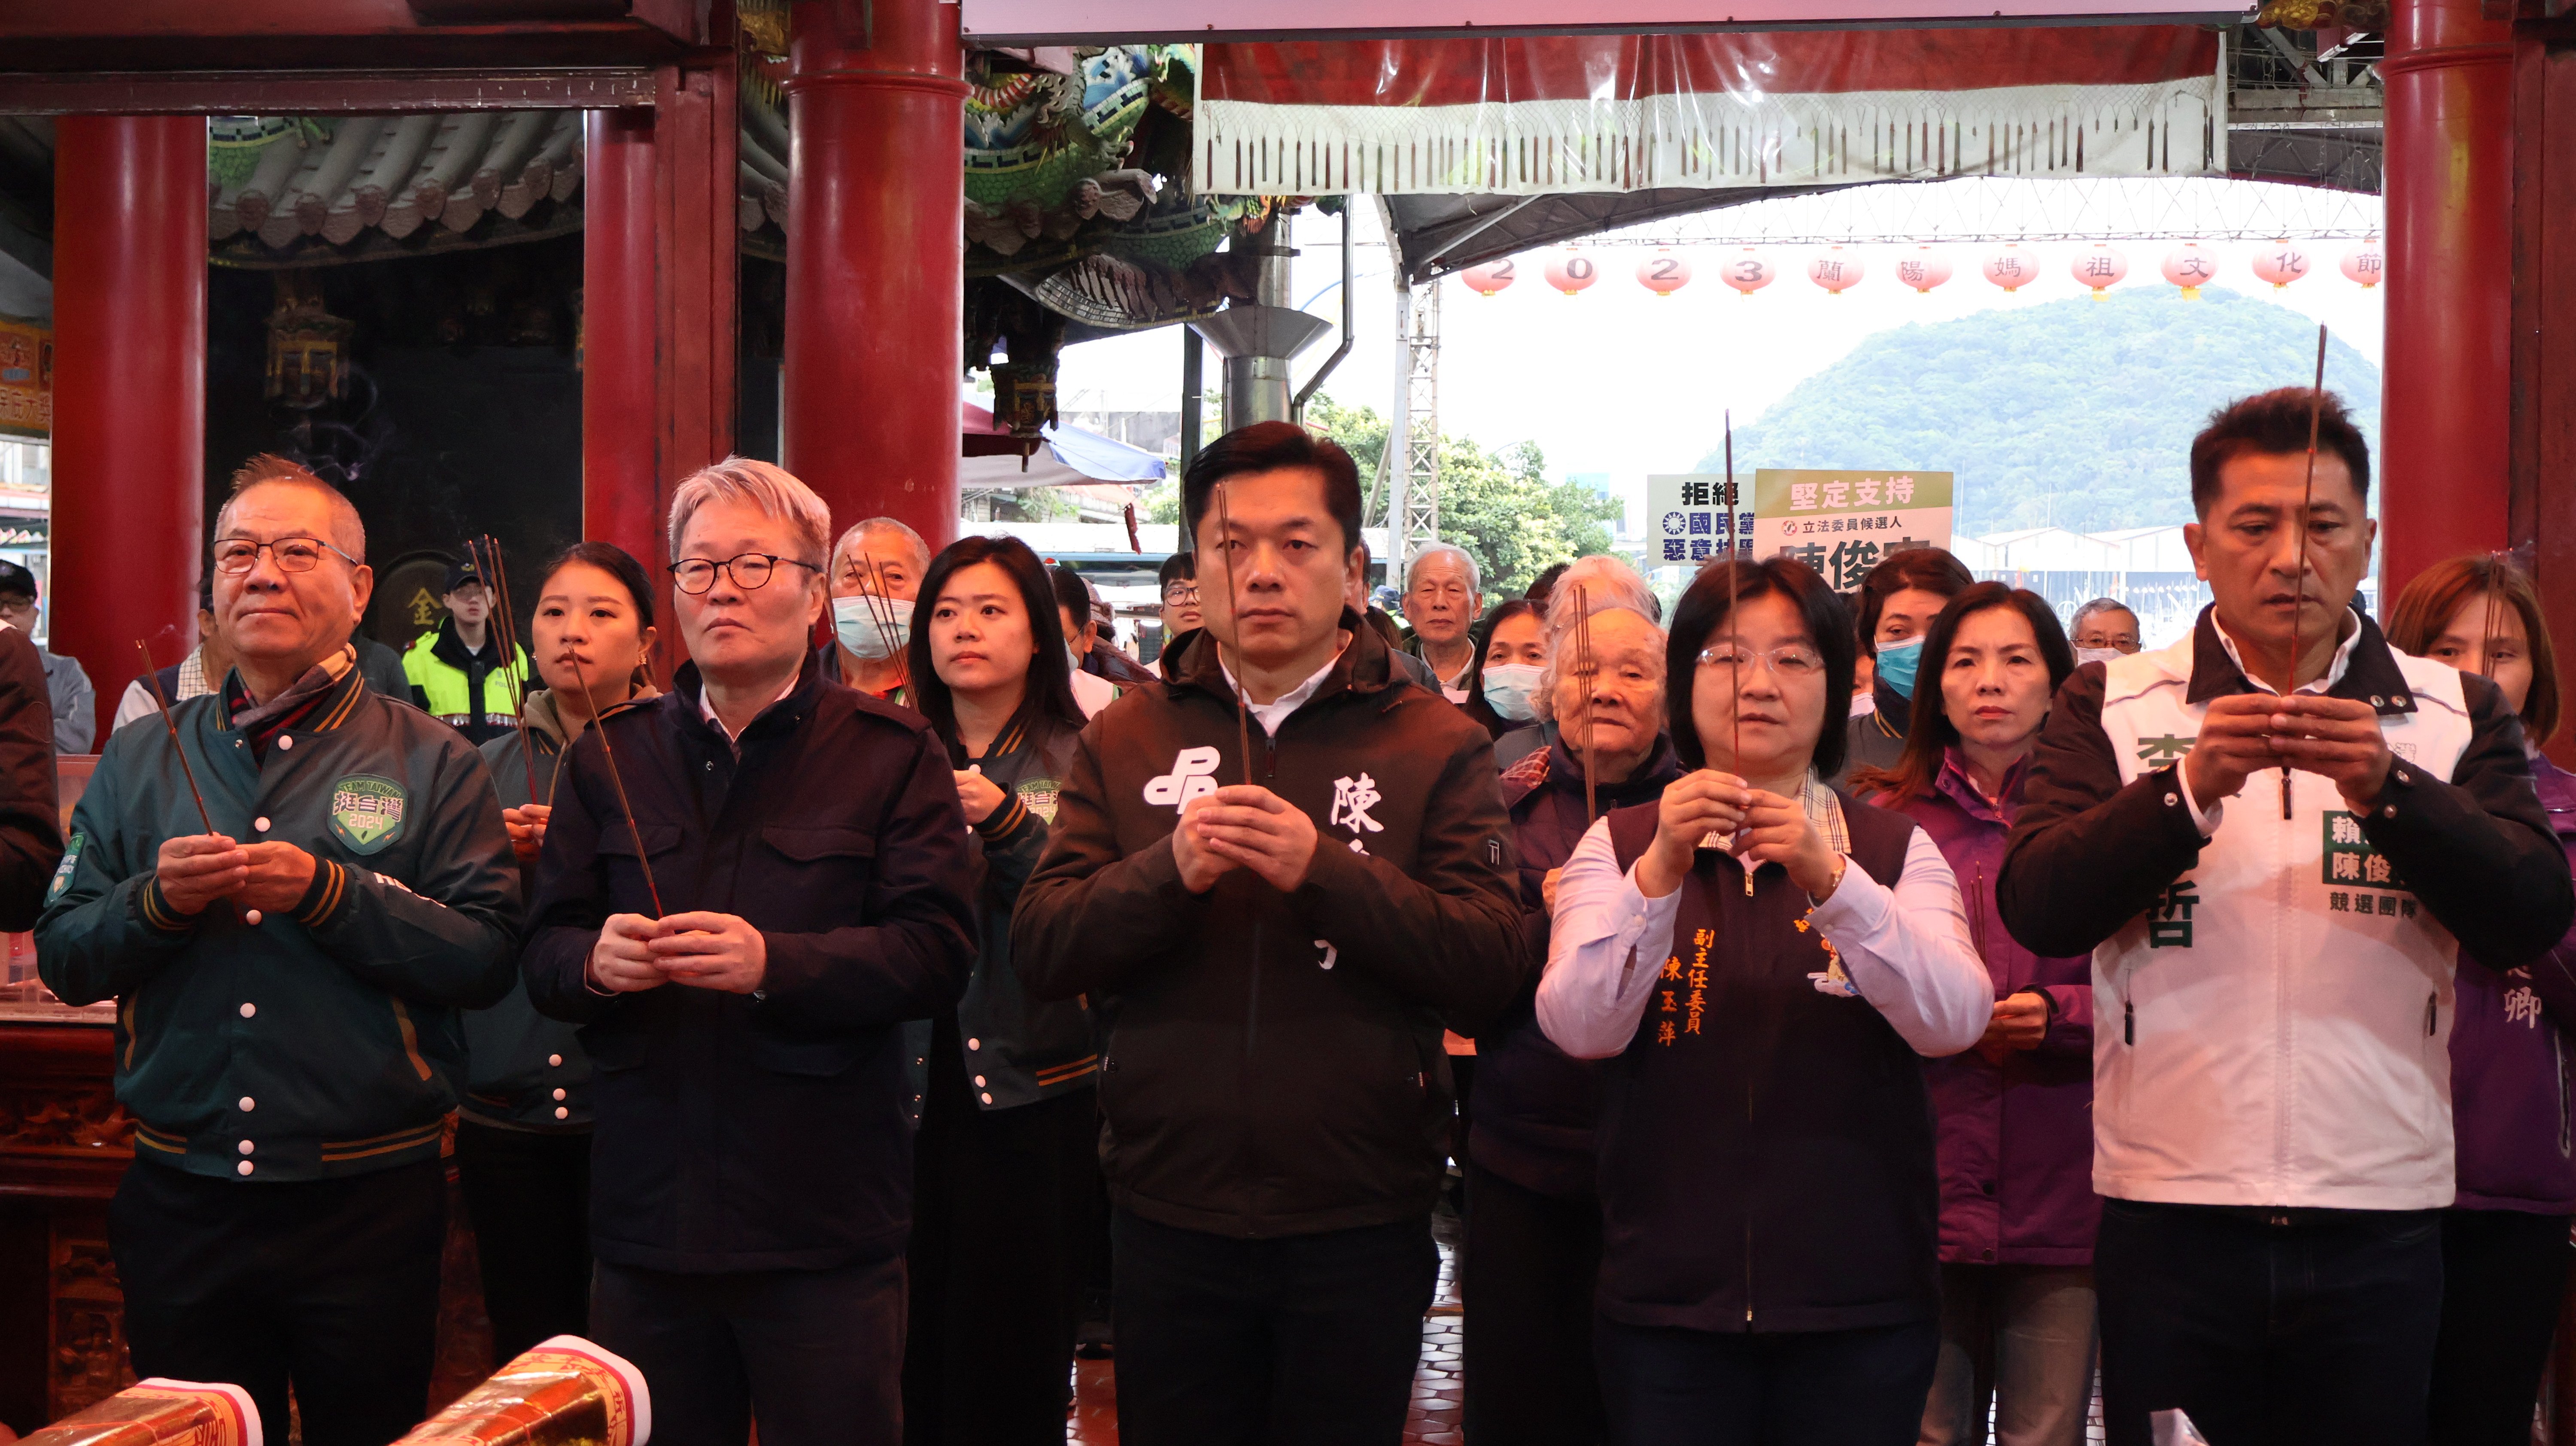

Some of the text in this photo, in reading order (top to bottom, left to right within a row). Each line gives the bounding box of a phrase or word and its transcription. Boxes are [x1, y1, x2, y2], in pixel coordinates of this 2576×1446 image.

[1682, 481, 1739, 506] 拒絕
[1789, 475, 1914, 511] 堅定支持
[1802, 516, 1902, 534] 立法委員候選人
[408, 588, 441, 625] 金
[339, 781, 401, 798] TEAM TAIWAN
[333, 790, 404, 822] 挺台灣
[349, 813, 384, 830] 2024
[2332, 851, 2404, 886] 陳俊
[1684, 929, 1715, 1035] 副主任委員
